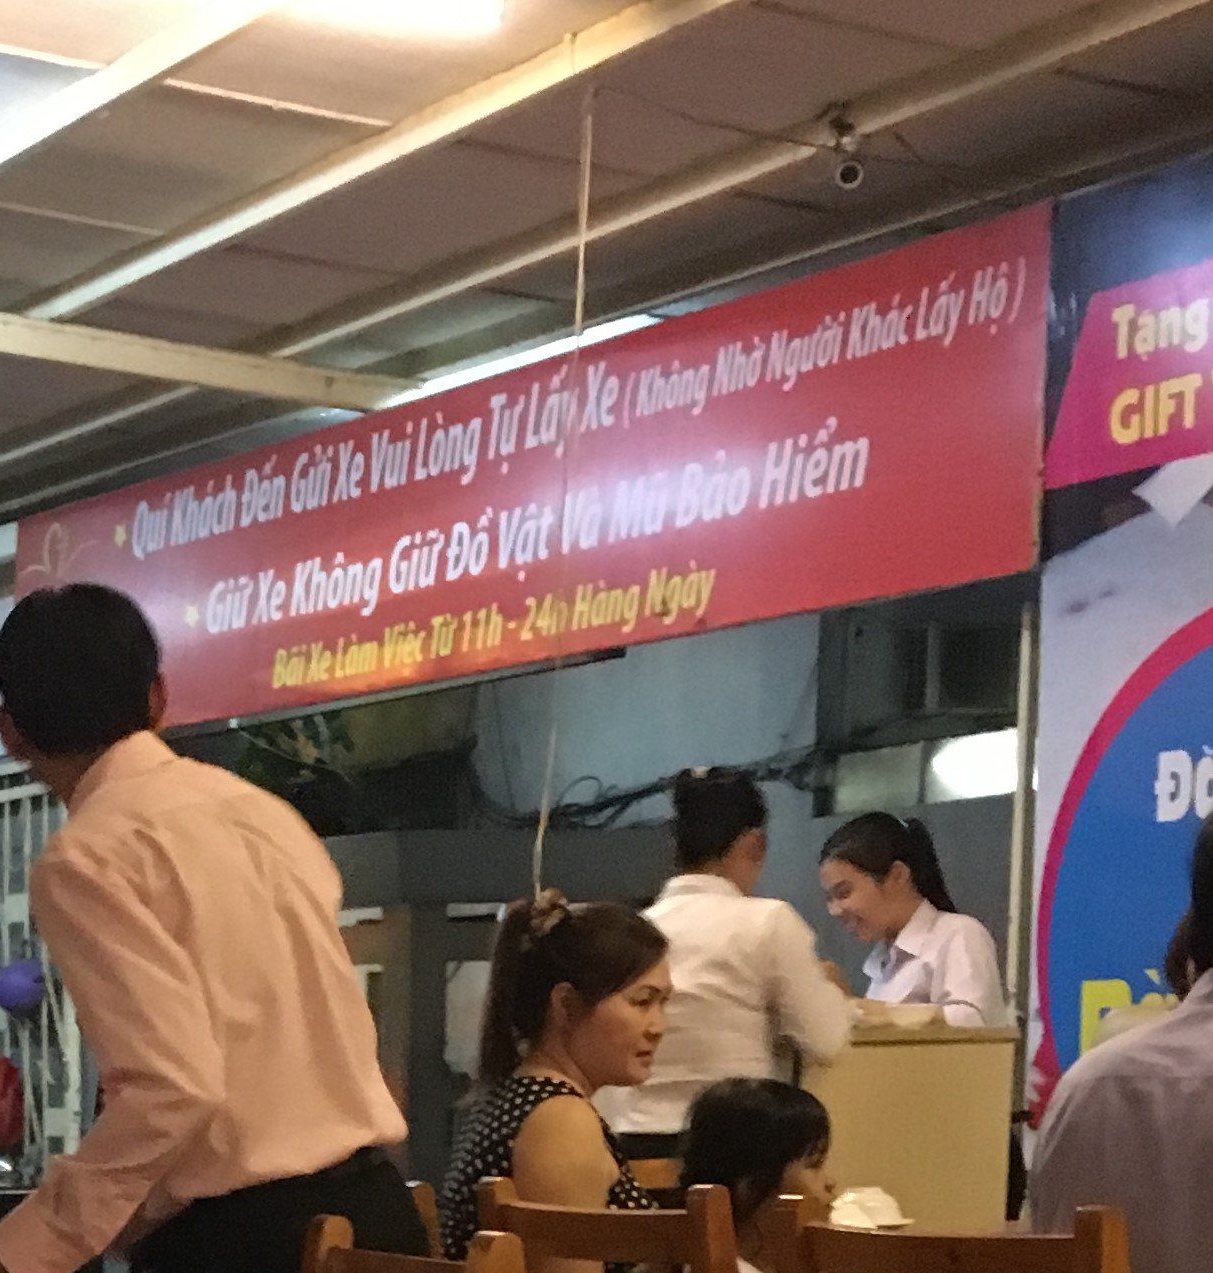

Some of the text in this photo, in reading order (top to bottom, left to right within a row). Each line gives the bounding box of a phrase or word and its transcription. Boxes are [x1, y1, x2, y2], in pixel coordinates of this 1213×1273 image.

[170, 474, 236, 546] Khách
[240, 454, 285, 528] Đến
[291, 444, 334, 513] Gửi
[333, 440, 364, 503] Xe
[370, 420, 413, 493] Vui
[414, 411, 482, 485] Lòng
[488, 393, 525, 474] Tự
[525, 364, 579, 459] Lấy
[580, 361, 619, 432] Xe
[712, 336, 766, 396] Nhờ
[765, 311, 846, 391] Người
[847, 293, 913, 360] Khác
[915, 270, 965, 348] Lấy
[1110, 373, 1203, 445] GIFT
[206, 576, 254, 633] Giữ
[252, 569, 286, 625] Xe
[290, 552, 383, 616] Không
[389, 528, 445, 593] Giữ
[446, 506, 493, 581] Đồ
[498, 502, 553, 582] Vật
[562, 484, 603, 554] Và
[676, 449, 751, 528] Bảo
[759, 416, 870, 509] Hiểm
[306, 641, 332, 683] Xe
[335, 632, 378, 678] Làm
[384, 621, 426, 669] Việc
[429, 613, 458, 659] Từ
[572, 579, 640, 633] Hàng
[644, 559, 716, 625] Ngày
